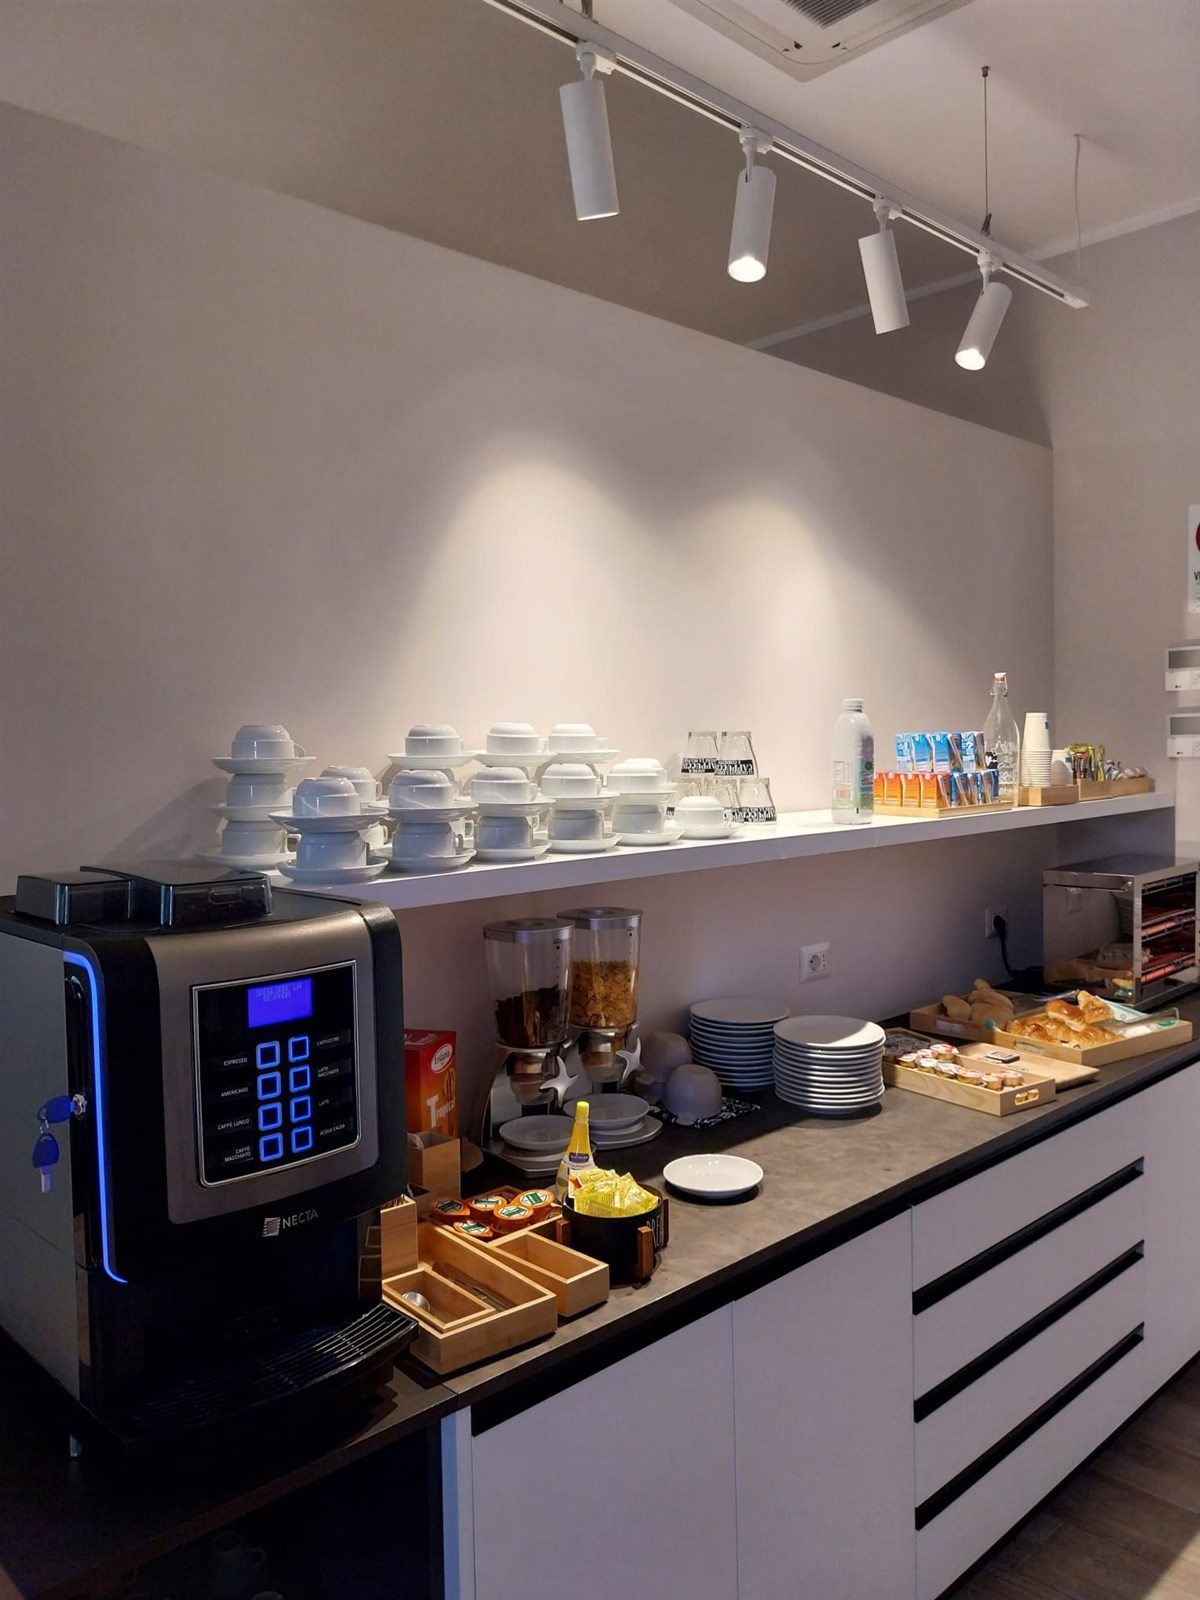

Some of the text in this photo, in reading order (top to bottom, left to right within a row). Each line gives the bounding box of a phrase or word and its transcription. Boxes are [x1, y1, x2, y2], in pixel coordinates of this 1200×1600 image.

[224, 1058, 248, 1066] ESPRESSO
[221, 1087, 249, 1097] AMERICANO
[233, 1118, 250, 1127] LUNGO
[332, 1123, 346, 1132] CALDA
[224, 1152, 251, 1162] MACCHIATO
[282, 1209, 318, 1229] NECTA
